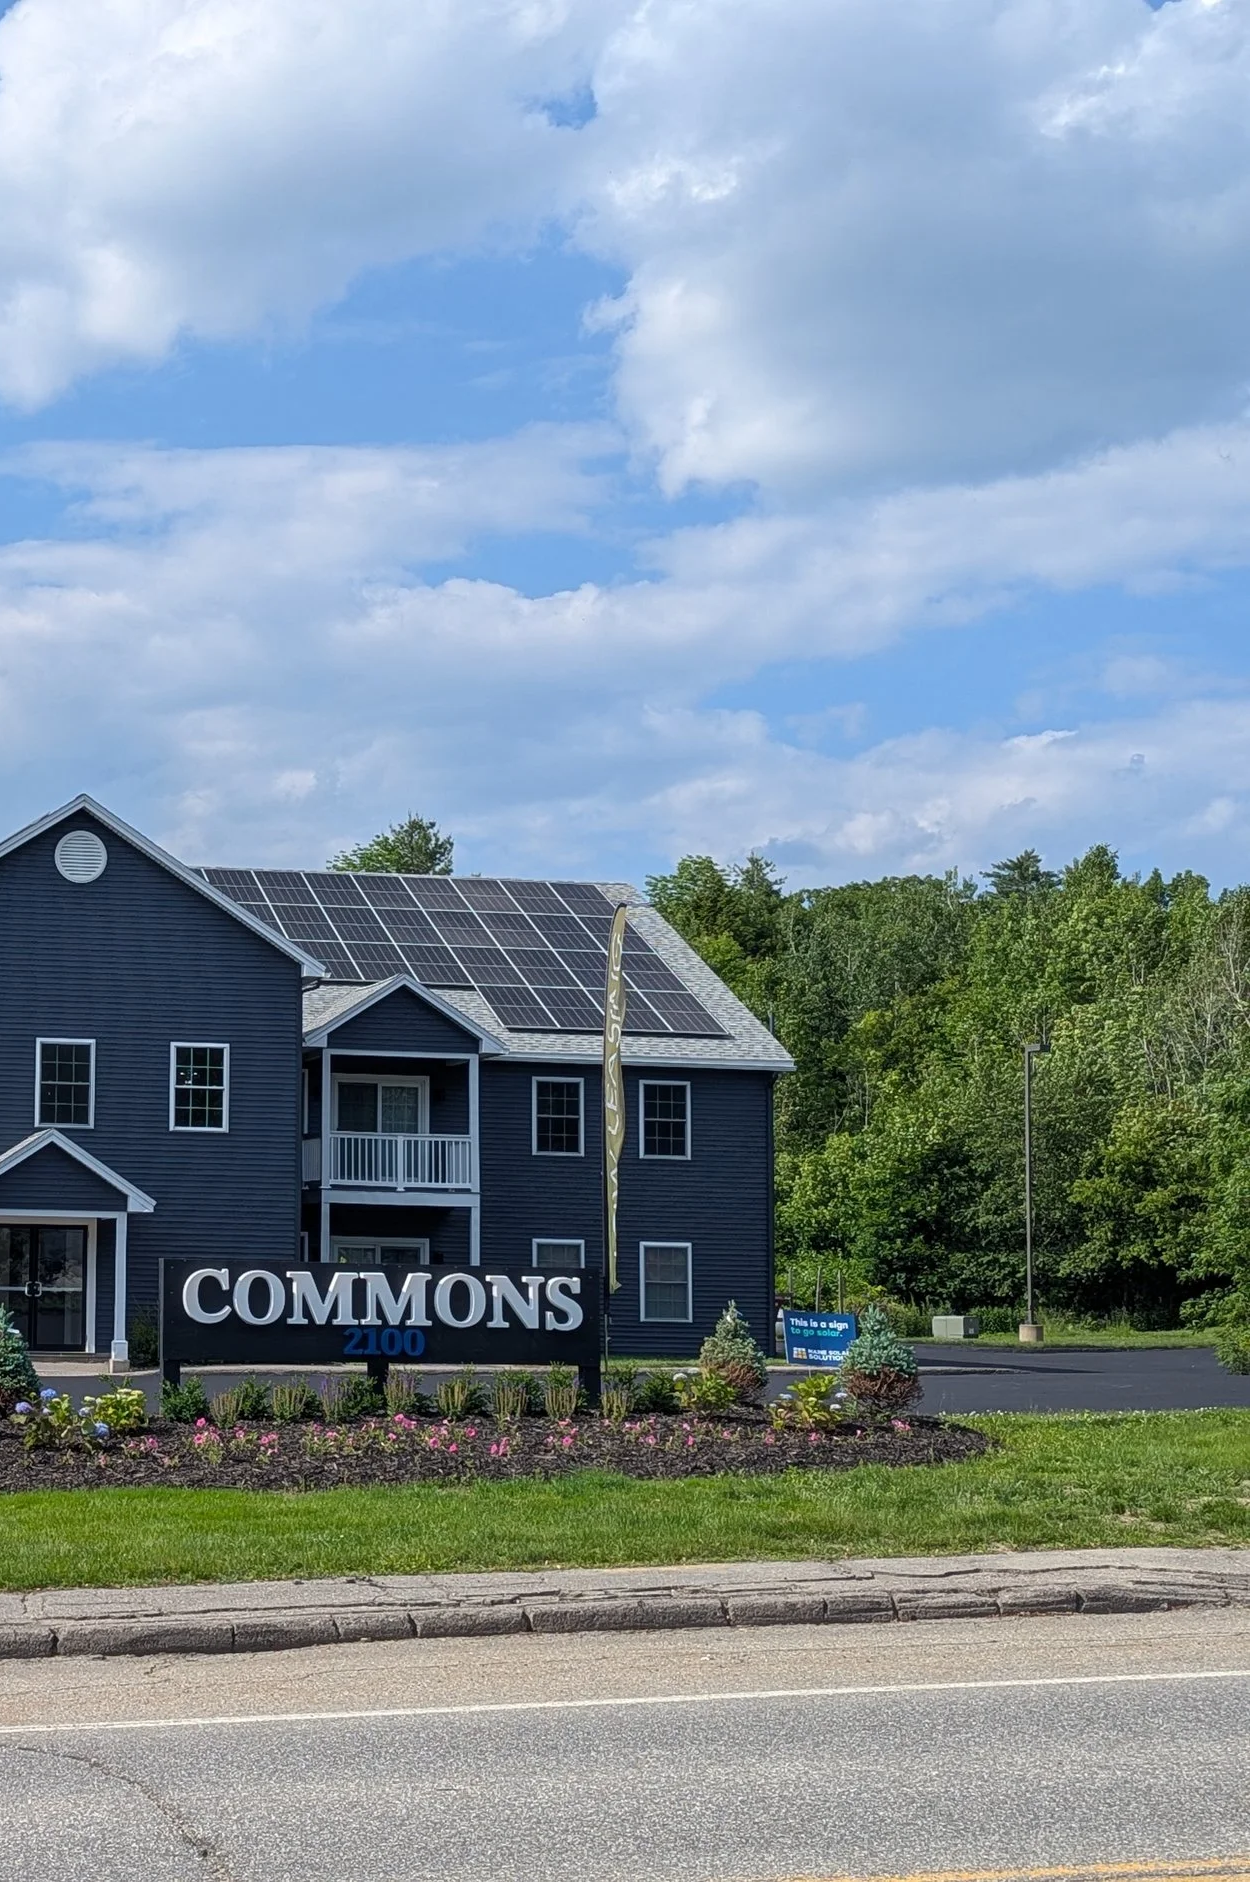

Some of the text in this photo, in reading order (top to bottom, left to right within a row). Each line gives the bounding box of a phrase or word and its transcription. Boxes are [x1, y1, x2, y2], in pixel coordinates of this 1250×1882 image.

[182, 1268, 584, 1331] COMMONS
[790, 1318, 808, 1327] This
[810, 1319, 818, 1327] is
[829, 1320, 848, 1331] sign
[803, 1329, 815, 1337] go
[817, 1329, 843, 1337] solar.
[343, 1327, 425, 1356] 2100
